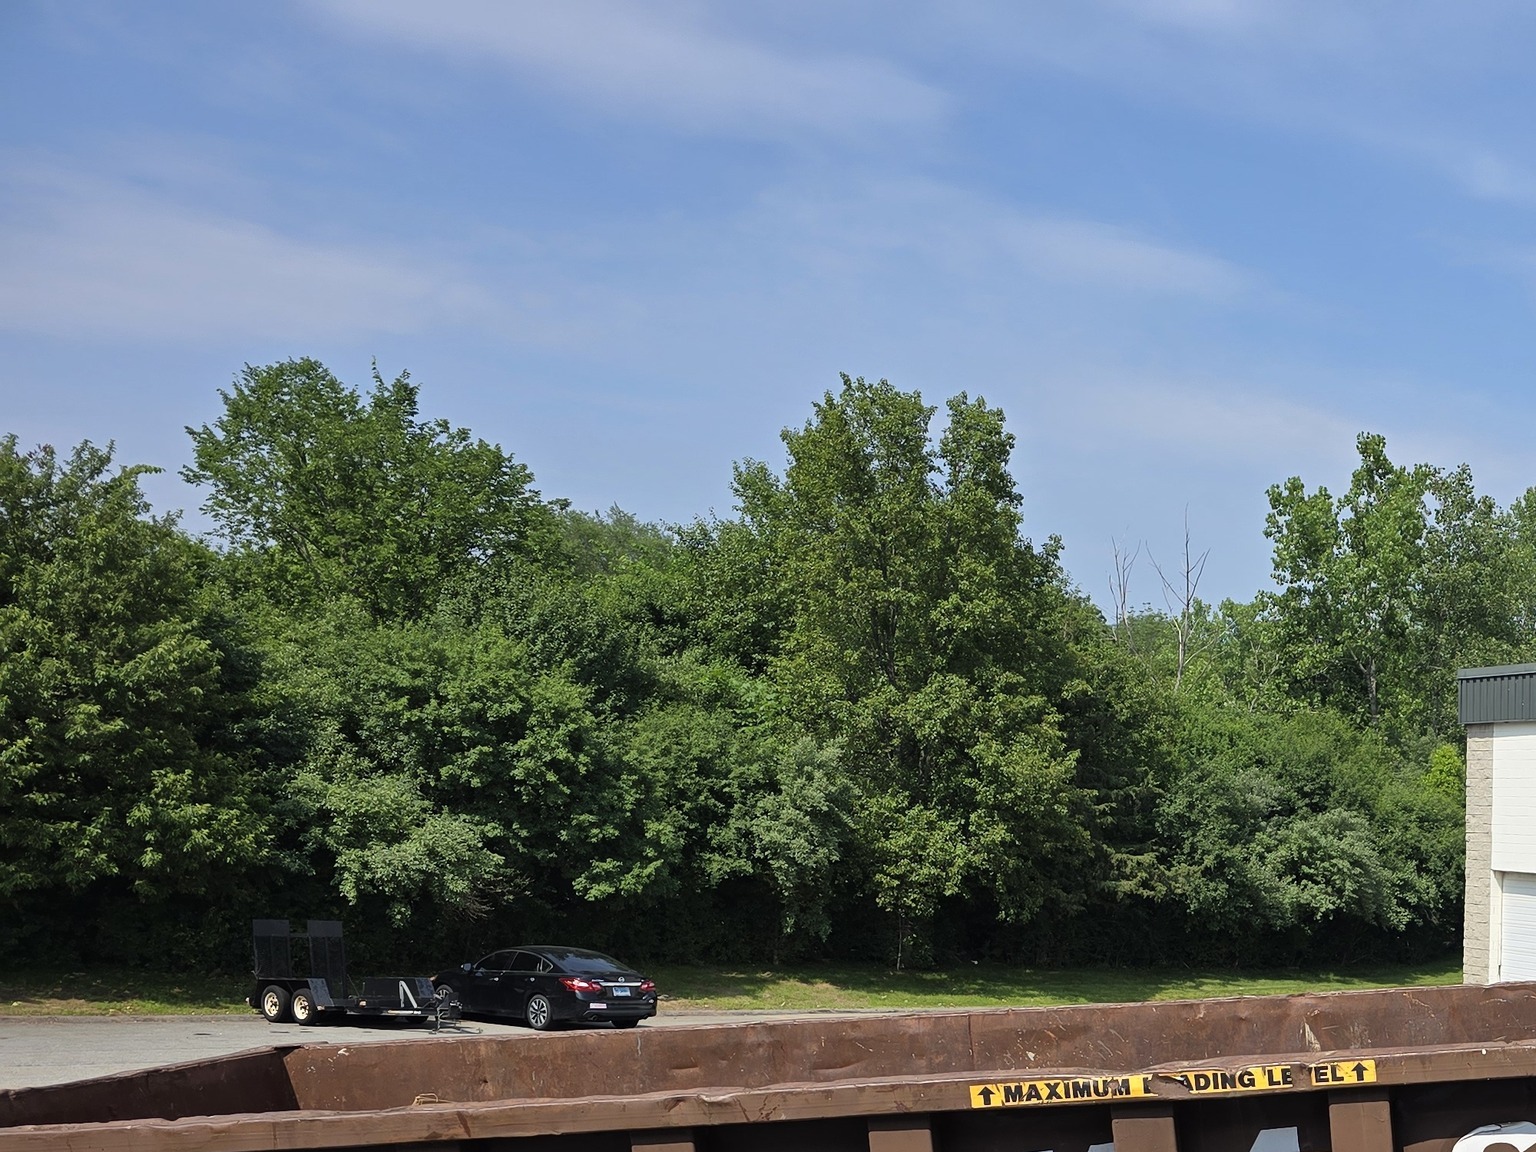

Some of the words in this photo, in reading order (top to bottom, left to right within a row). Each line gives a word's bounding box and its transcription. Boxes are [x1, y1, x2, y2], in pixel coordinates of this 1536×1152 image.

[1003, 1078, 1131, 1103] MAXIMUM
[1143, 1070, 1256, 1096] LADING
[1267, 1064, 1345, 1086] LEEL
